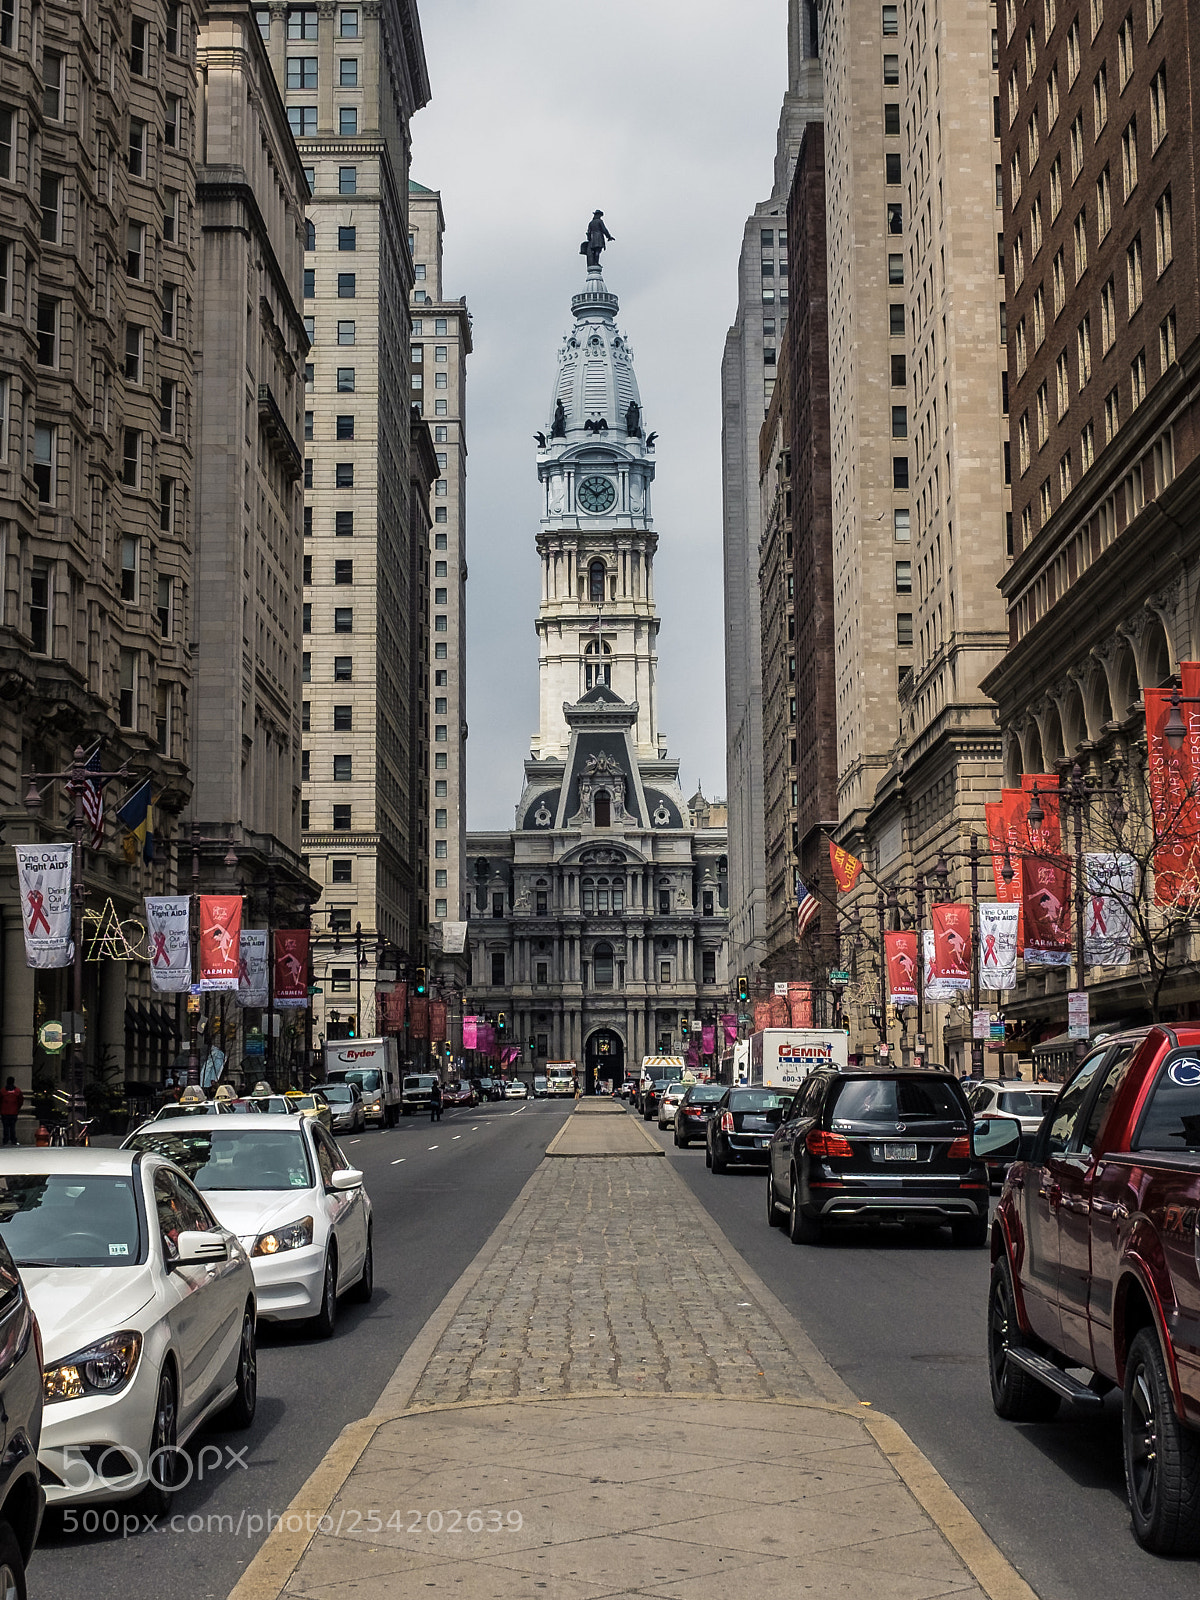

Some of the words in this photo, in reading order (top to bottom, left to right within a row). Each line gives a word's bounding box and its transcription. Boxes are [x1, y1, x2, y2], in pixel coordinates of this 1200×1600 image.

[1168, 759, 1181, 797] ARTS
[19, 853, 38, 863] Dine
[41, 853, 57, 863] Out
[25, 862, 47, 872] Fight
[49, 860, 68, 870] AIDS
[152, 910, 169, 919] Fight
[347, 1049, 376, 1059] Ryder
[778, 1044, 832, 1057] GEMINI
